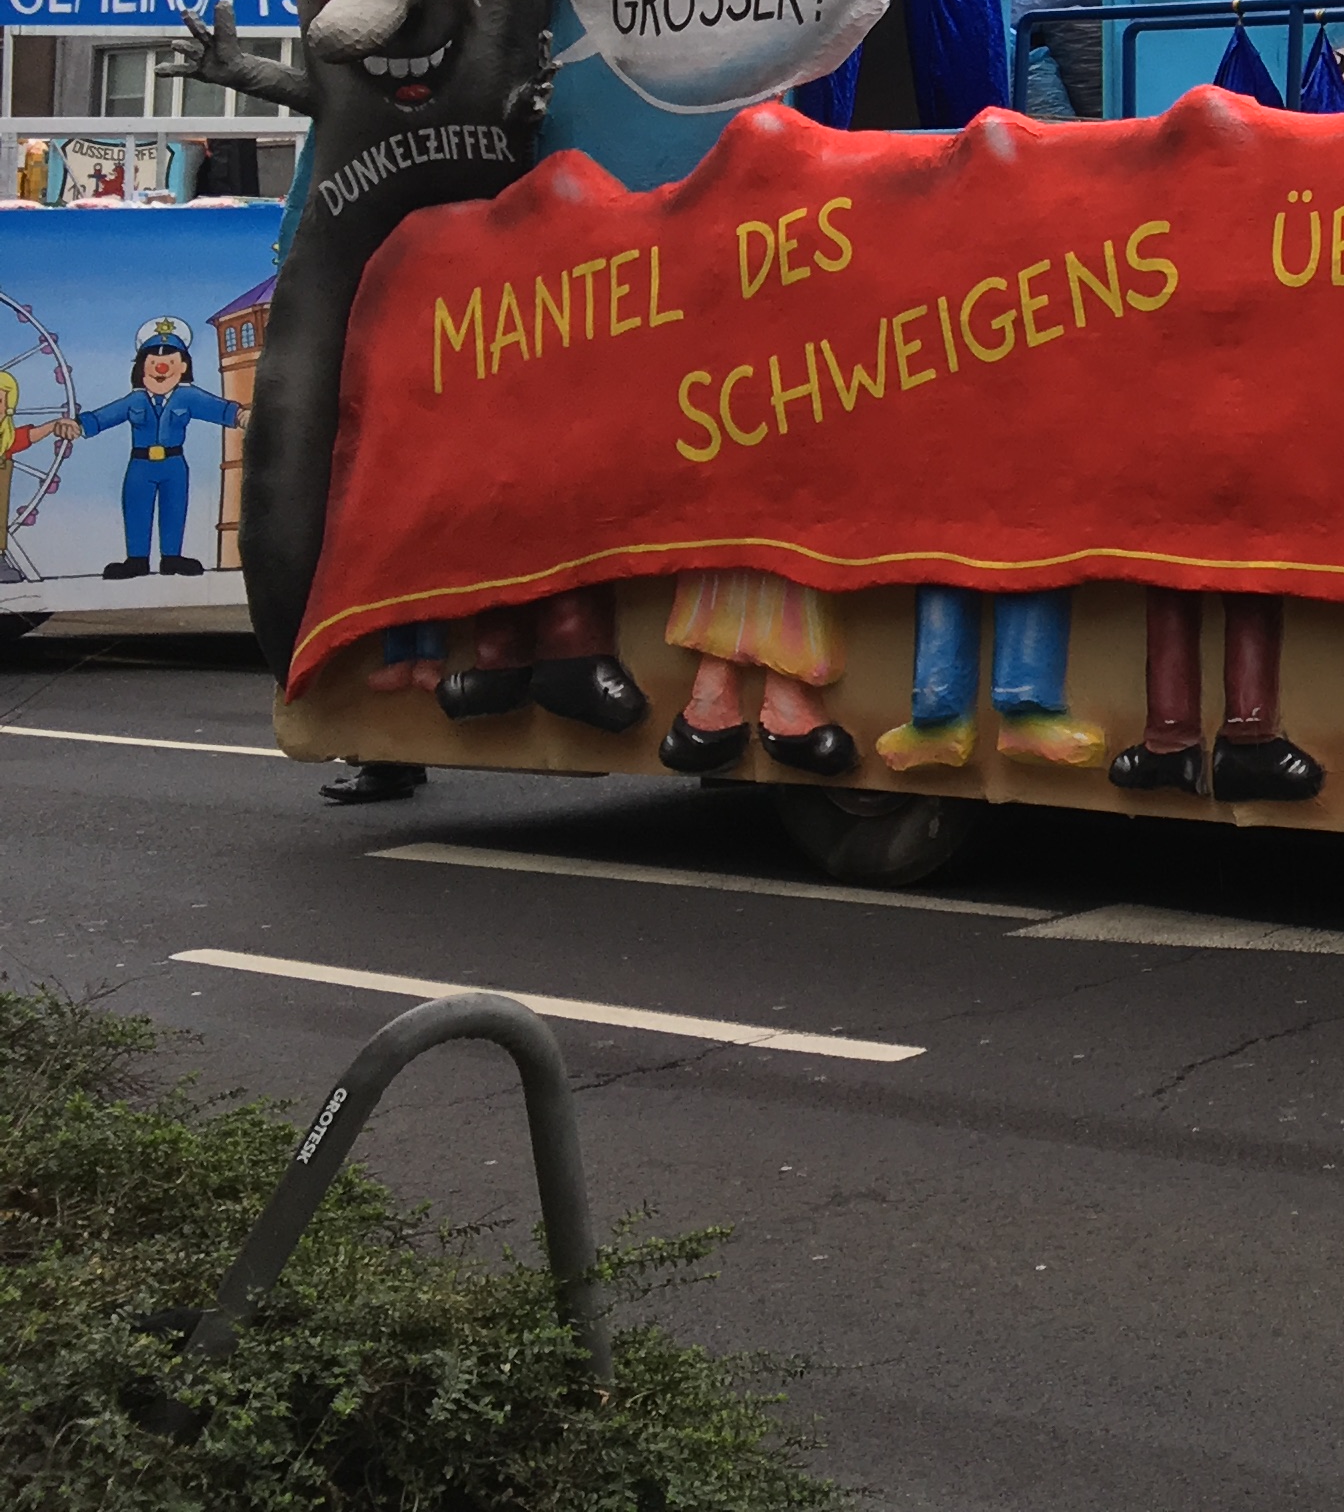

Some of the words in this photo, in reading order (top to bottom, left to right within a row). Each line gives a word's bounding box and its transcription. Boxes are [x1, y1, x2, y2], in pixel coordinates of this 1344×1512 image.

[318, 125, 515, 217] DUNKELZIFFER
[432, 245, 684, 394] MANTEL
[736, 196, 853, 299] DES
[676, 220, 1180, 462] SCHWEIGENS
[296, 1088, 347, 1164] GROTESK
